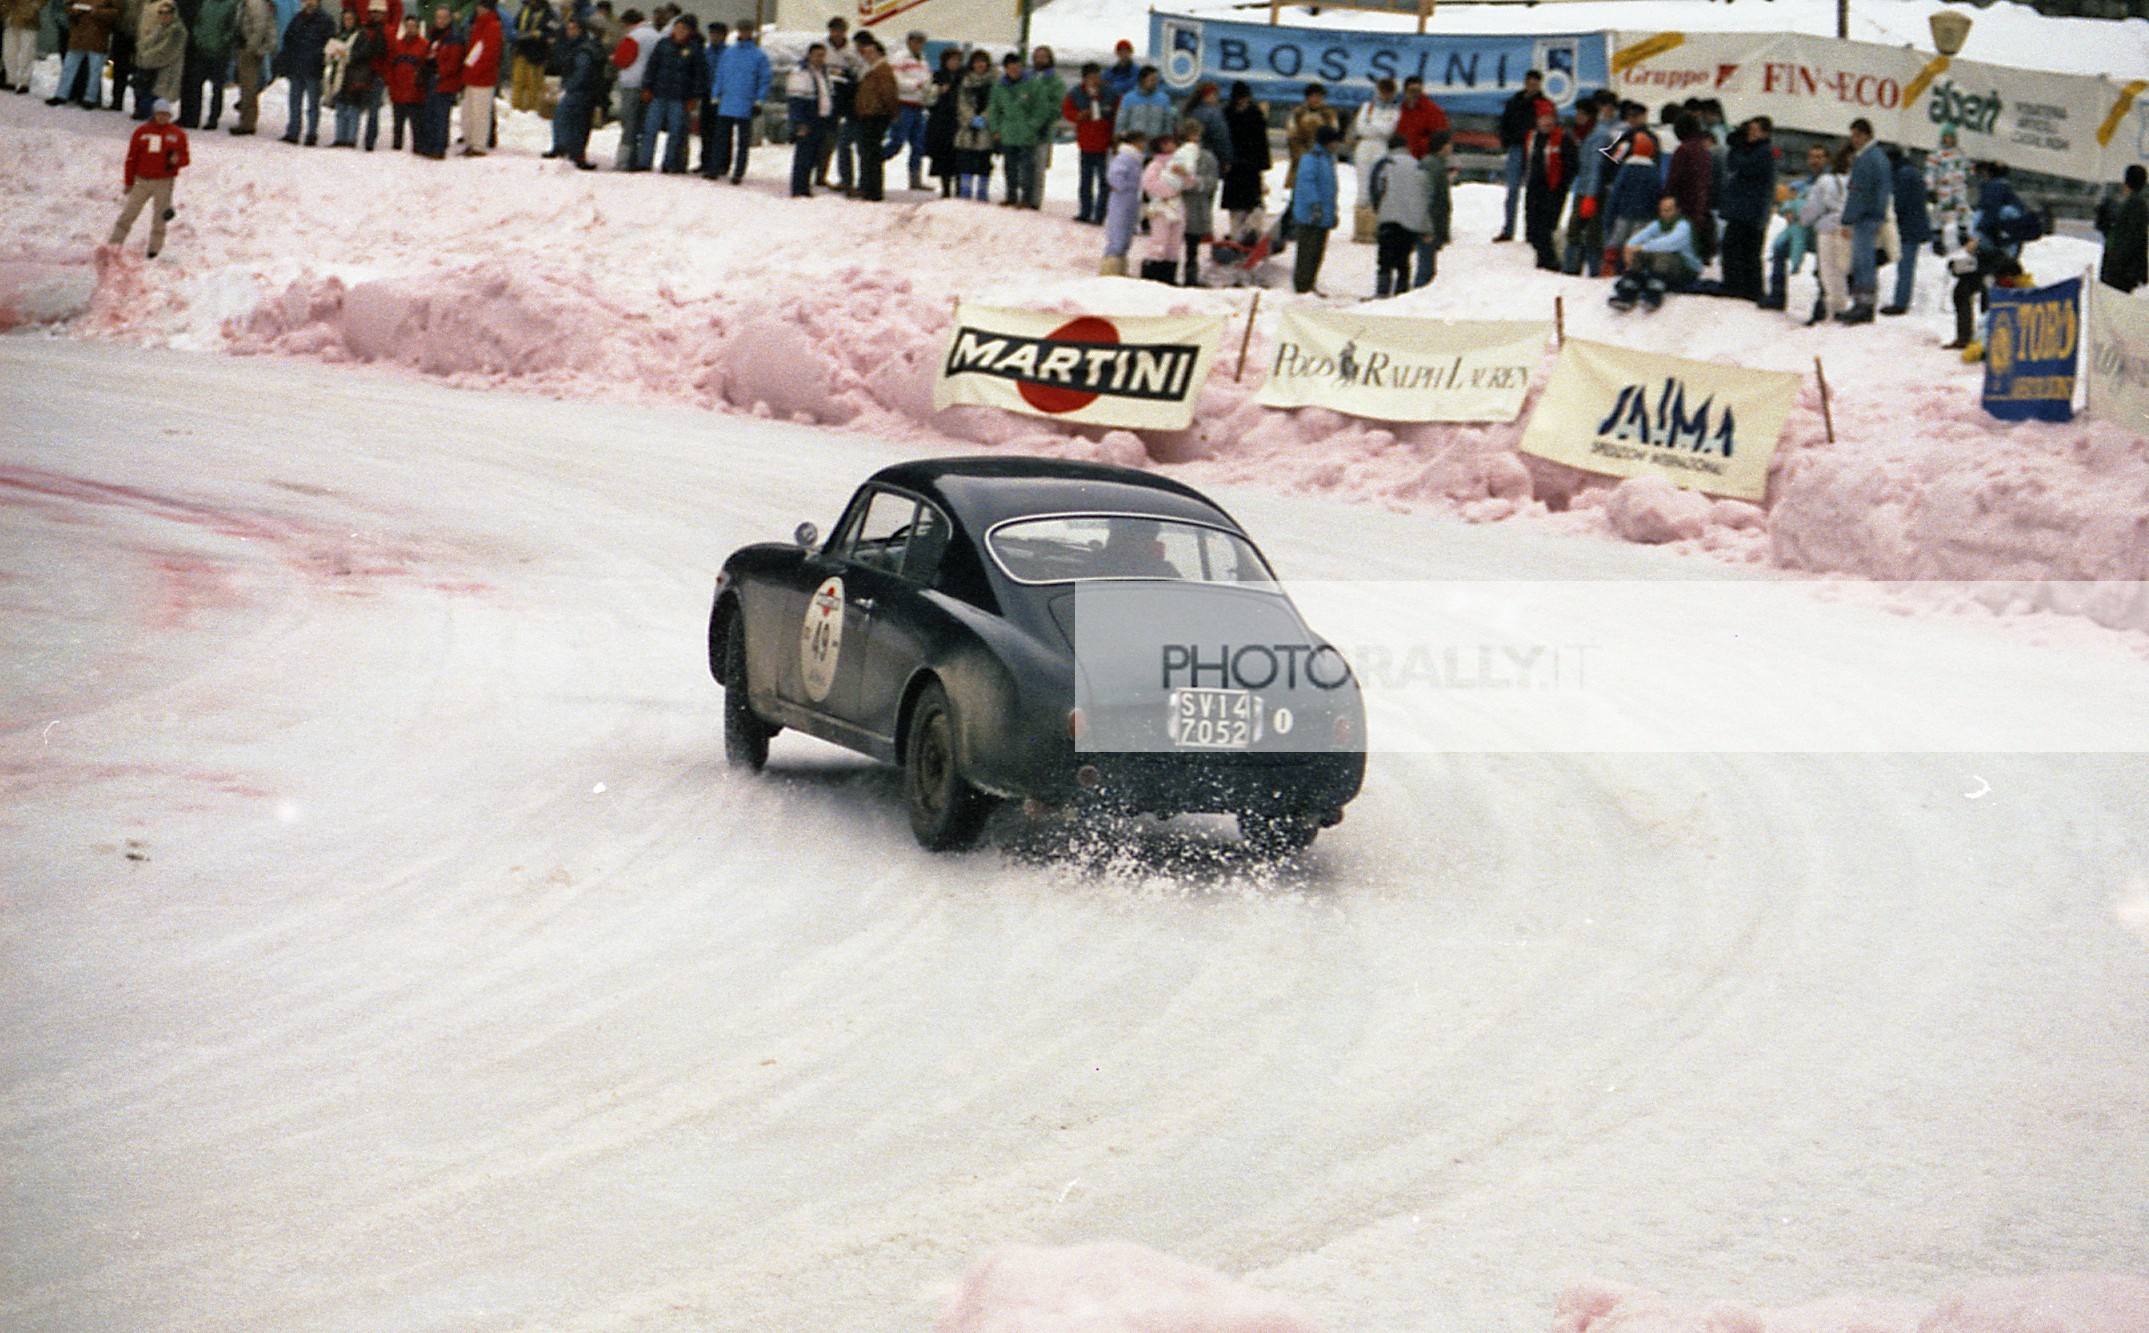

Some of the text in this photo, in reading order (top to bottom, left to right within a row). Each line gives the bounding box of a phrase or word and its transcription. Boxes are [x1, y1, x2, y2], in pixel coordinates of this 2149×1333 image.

[1219, 38, 1507, 88] BOSSINI
[1624, 64, 1711, 90] Gruppo
[952, 332, 1191, 395] MARTINI
[1181, 692, 1248, 719] SV14
[1181, 717, 1248, 745] 7052
